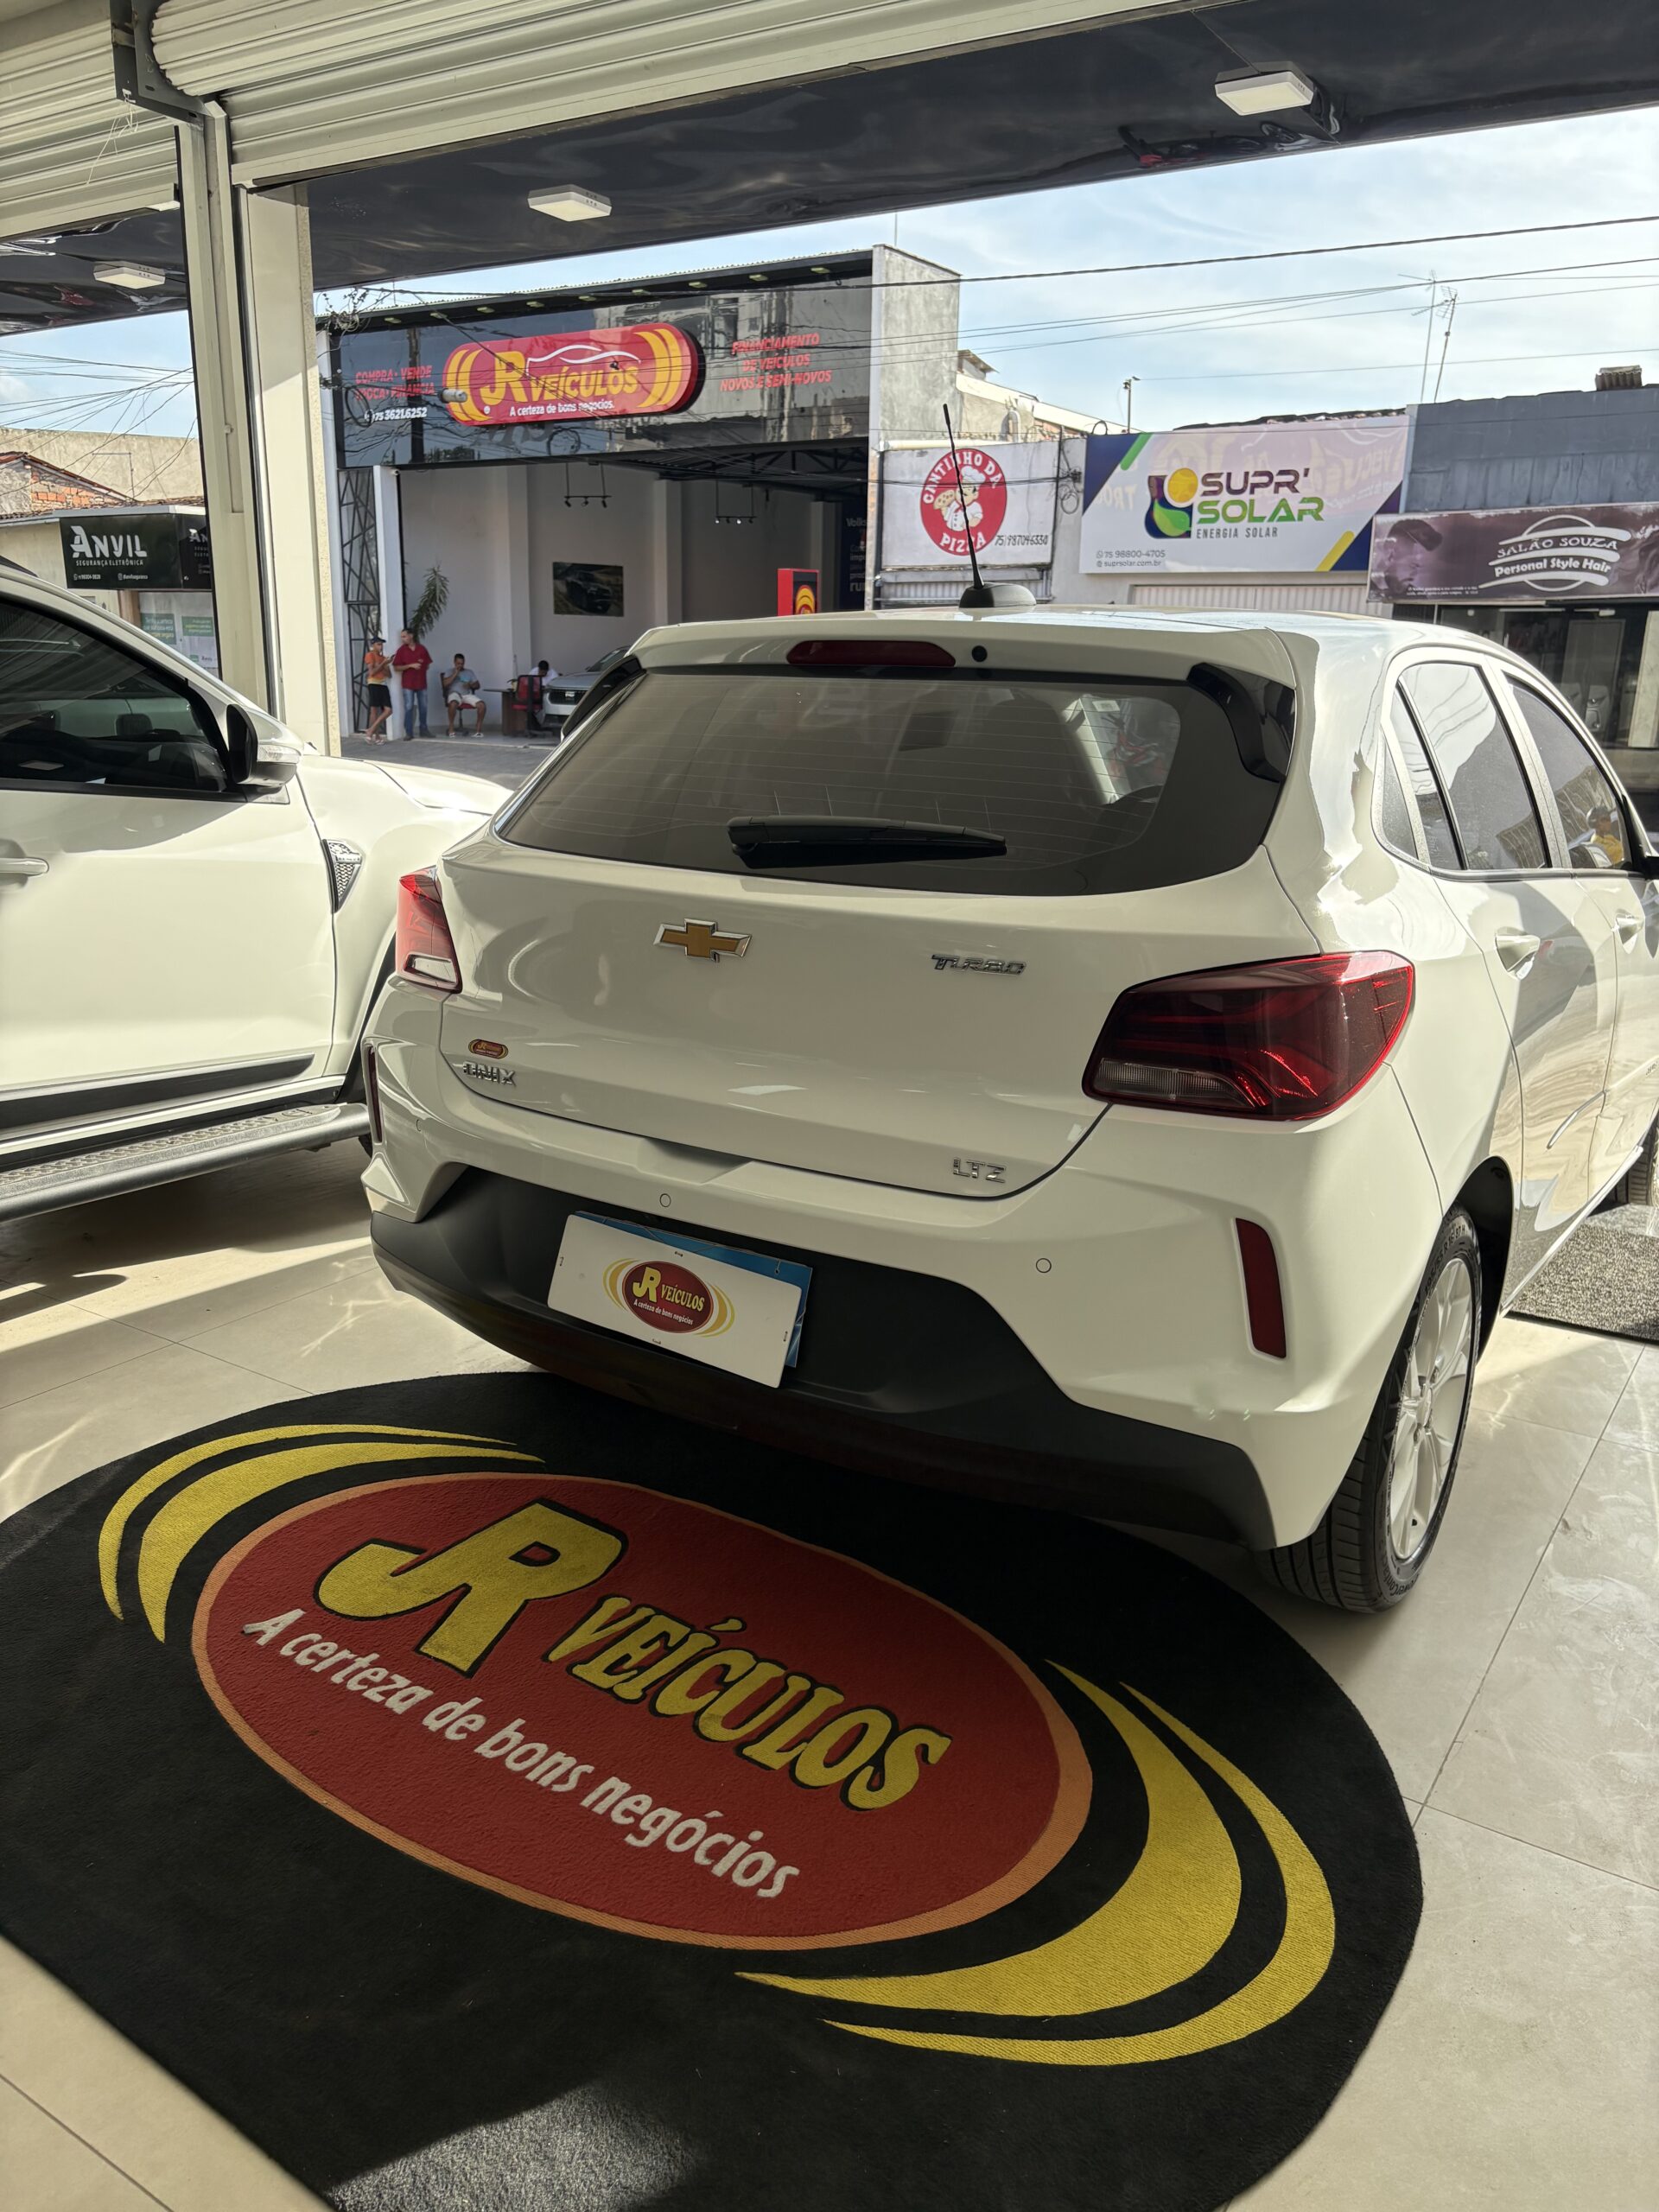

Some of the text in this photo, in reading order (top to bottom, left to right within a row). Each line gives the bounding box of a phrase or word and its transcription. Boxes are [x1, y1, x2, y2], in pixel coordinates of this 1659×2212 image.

[732, 333, 820, 355] FINANCIAMENTO
[401, 365, 432, 380] VENDE
[742, 359, 757, 372] DE
[480, 351, 529, 406] JR
[531, 366, 639, 402] VEÍCULOS
[720, 371, 832, 391] NOVOS E SEMI-NOVOS
[374, 412, 385, 421] 75
[509, 406, 517, 416] A
[518, 403, 545, 416] certeza
[546, 404, 556, 414] de
[923, 451, 1004, 504] CANTINHO DA
[1197, 497, 1325, 524] SOLAR
[939, 531, 987, 553] PIZA
[1197, 527, 1278, 539] ENERGIA SOLAR
[1497, 536, 1618, 558] SALÃO SOUZA
[109, 558, 144, 567] ELETRÔNICA
[1494, 557, 1612, 578] Personal Style Hair
[931, 954, 1027, 975] TURBO
[462, 1061, 517, 1085] ONIX
[953, 1157, 1006, 1184] LTZ
[632, 1267, 705, 1312] JR VEÍCULOS
[314, 1497, 952, 1811] JR VEÍCULOS
[242, 1608, 799, 1899] A certeza de bons negócios
